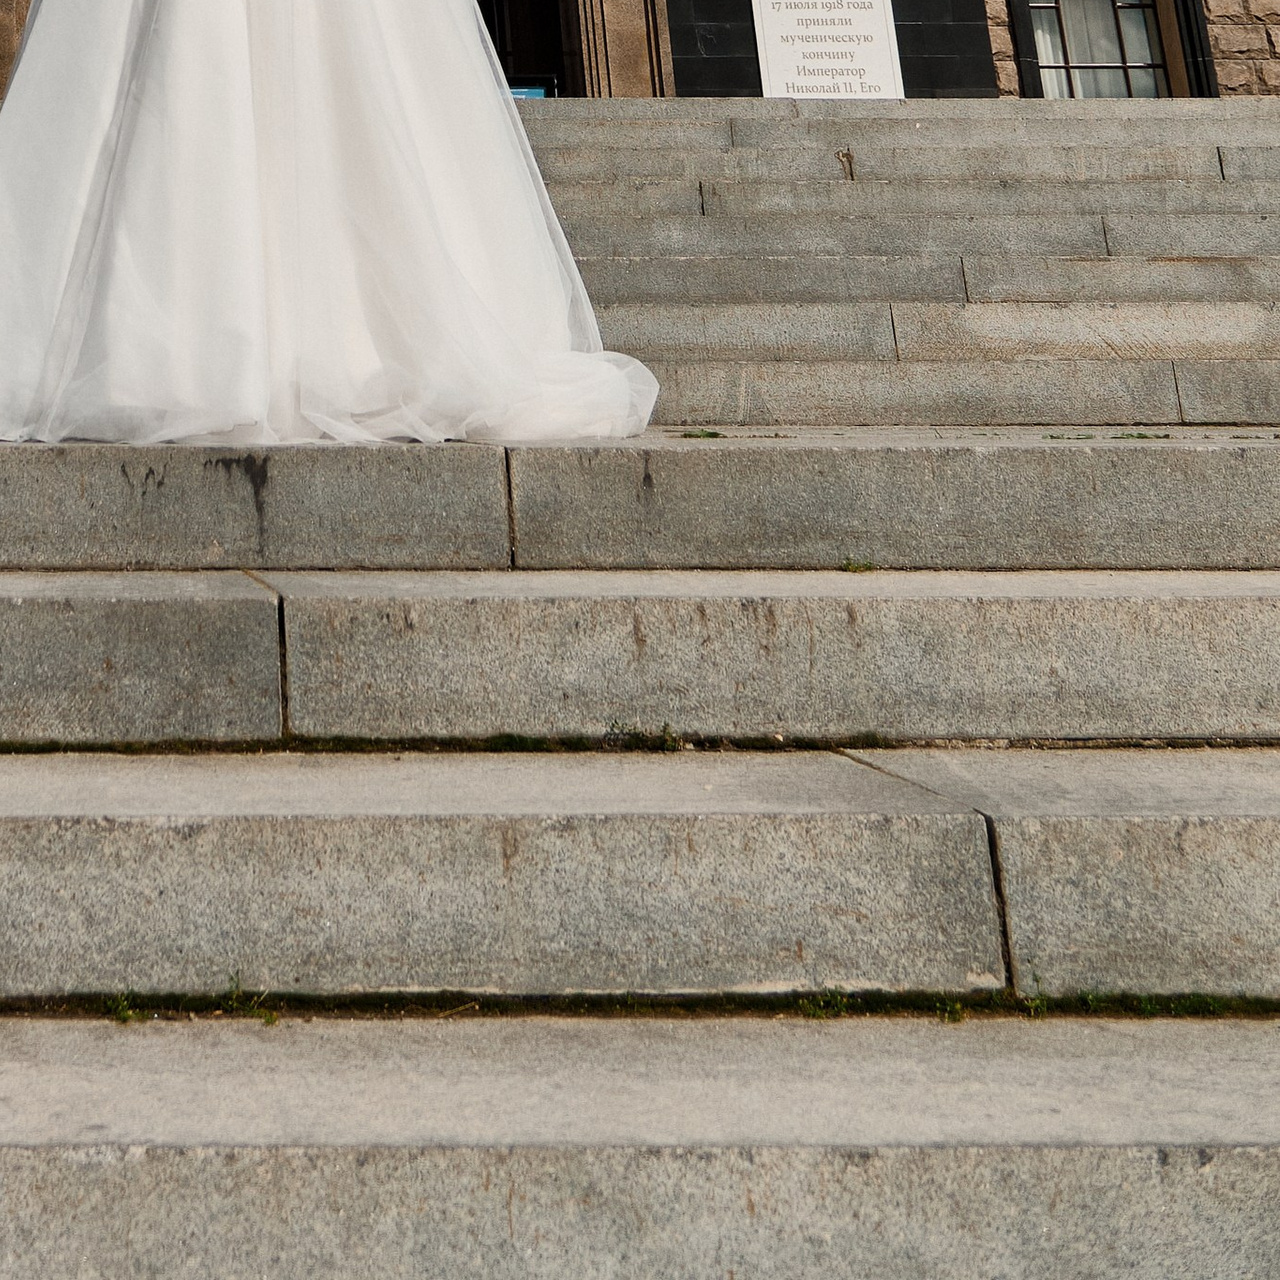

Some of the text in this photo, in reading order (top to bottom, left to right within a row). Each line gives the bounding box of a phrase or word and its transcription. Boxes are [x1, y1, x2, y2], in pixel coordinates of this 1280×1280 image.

[771, 0, 873, 12] 17 июля 1918 года
[797, 18, 852, 29] приняли
[780, 34, 873, 45] мученическую
[802, 51, 855, 62] кончину
[796, 65, 866, 79] Император
[785, 82, 840, 93] Николай
[860, 82, 881, 93] Его
